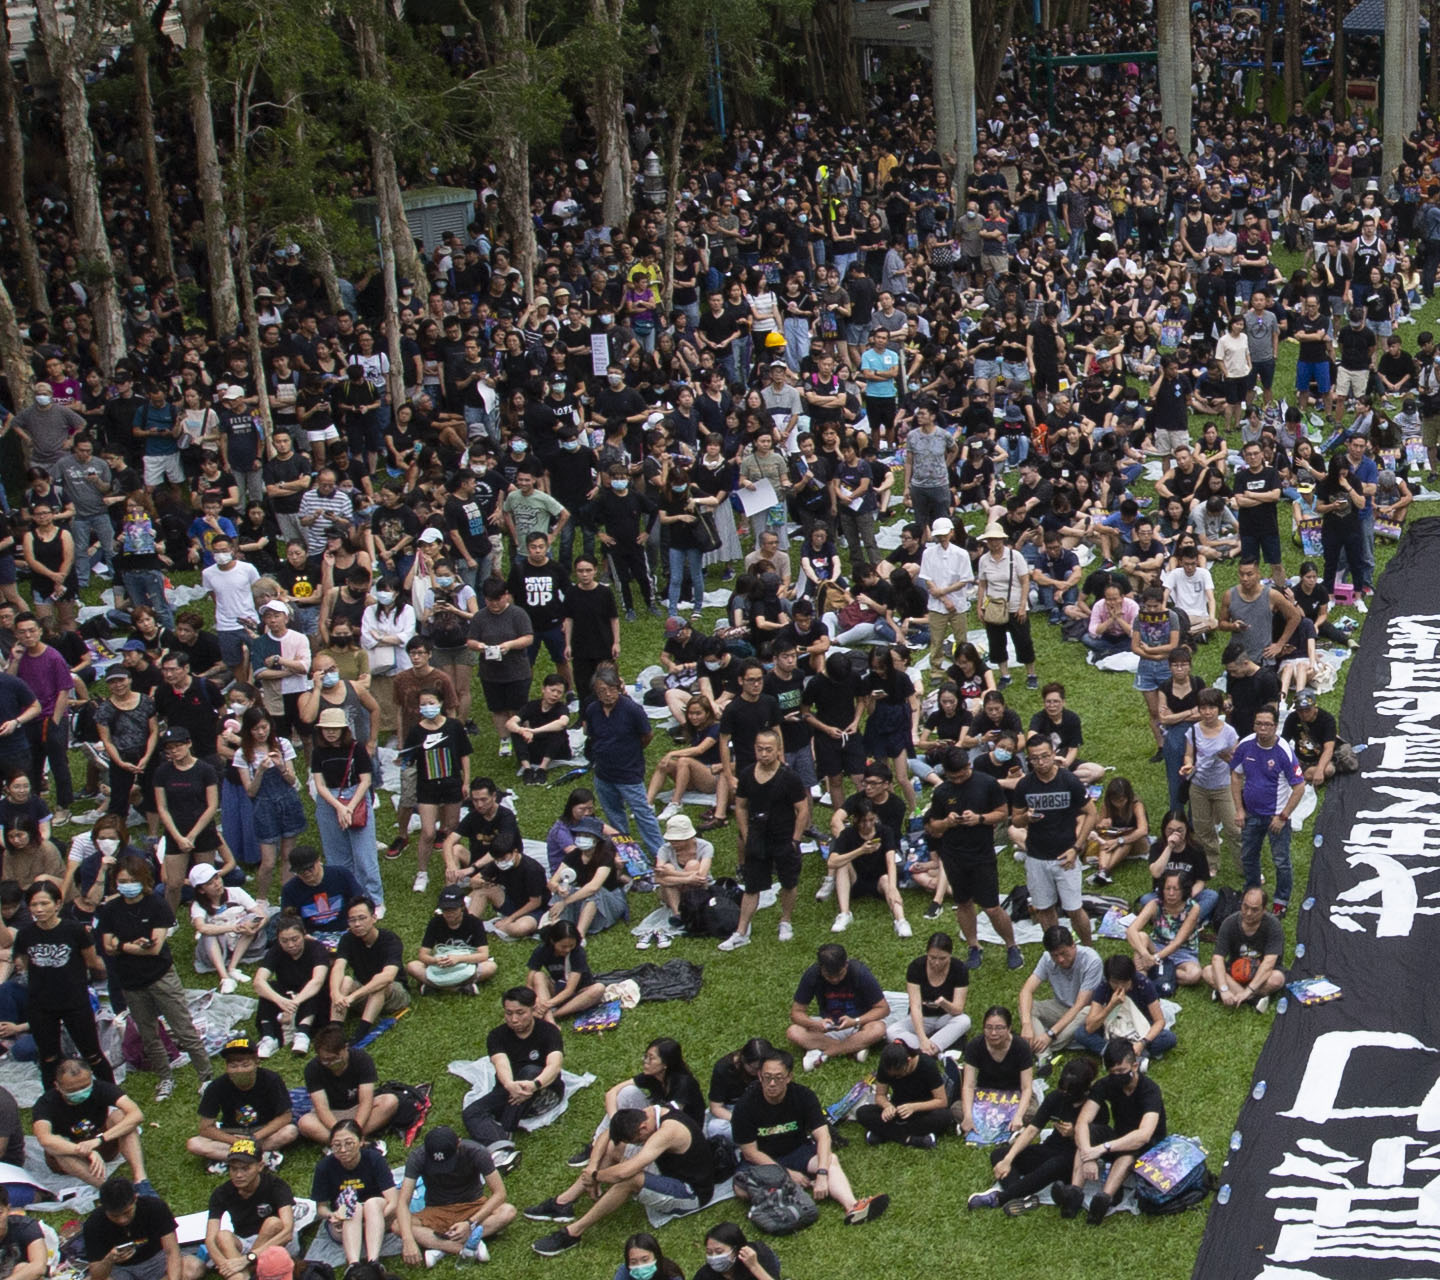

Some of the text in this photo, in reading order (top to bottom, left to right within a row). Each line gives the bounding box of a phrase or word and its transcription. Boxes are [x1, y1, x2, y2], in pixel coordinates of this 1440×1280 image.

[525, 576, 553, 585] NEVER
[525, 583, 553, 593] GIVE
[527, 592, 553, 607] UP
